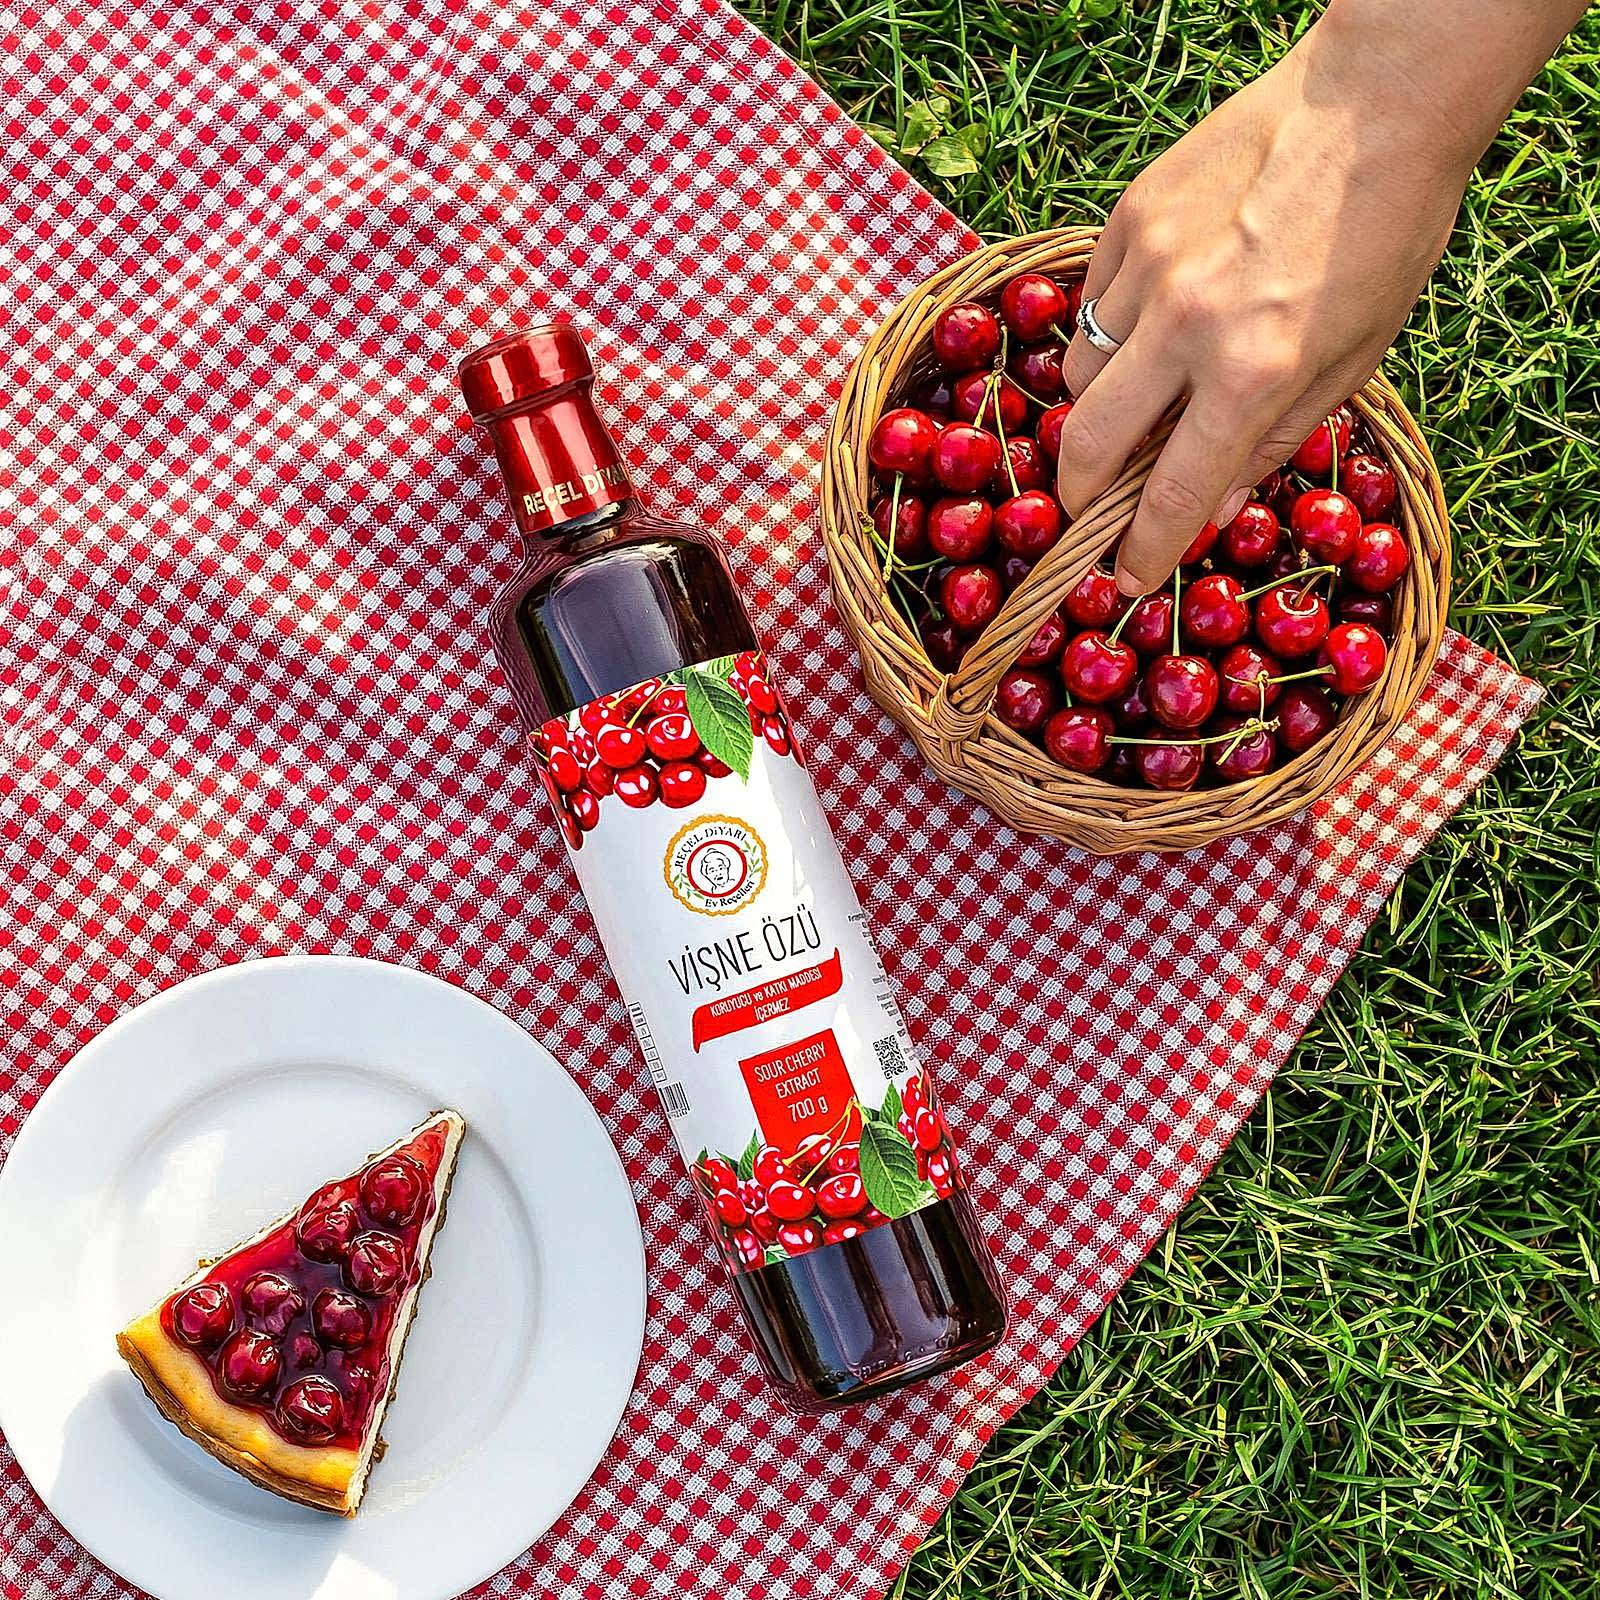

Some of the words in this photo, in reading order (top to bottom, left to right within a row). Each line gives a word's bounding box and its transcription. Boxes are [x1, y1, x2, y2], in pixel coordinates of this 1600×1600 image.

[674, 833, 704, 869] REÇEL
[704, 898, 719, 908] Ev
[667, 931, 763, 995] VİŞNE
[761, 903, 822, 962] ÖZÜ
[709, 992, 753, 1018] KORUYUCU
[752, 990, 764, 1002] ve
[763, 980, 789, 999] KATKI
[753, 996, 791, 1022] İÇERMEZ
[753, 1059, 788, 1083] SOUR
[784, 1041, 826, 1073] CHERRY
[775, 1067, 821, 1099] EXTRACT
[787, 1097, 816, 1123] 700
[817, 1095, 829, 1114] g
